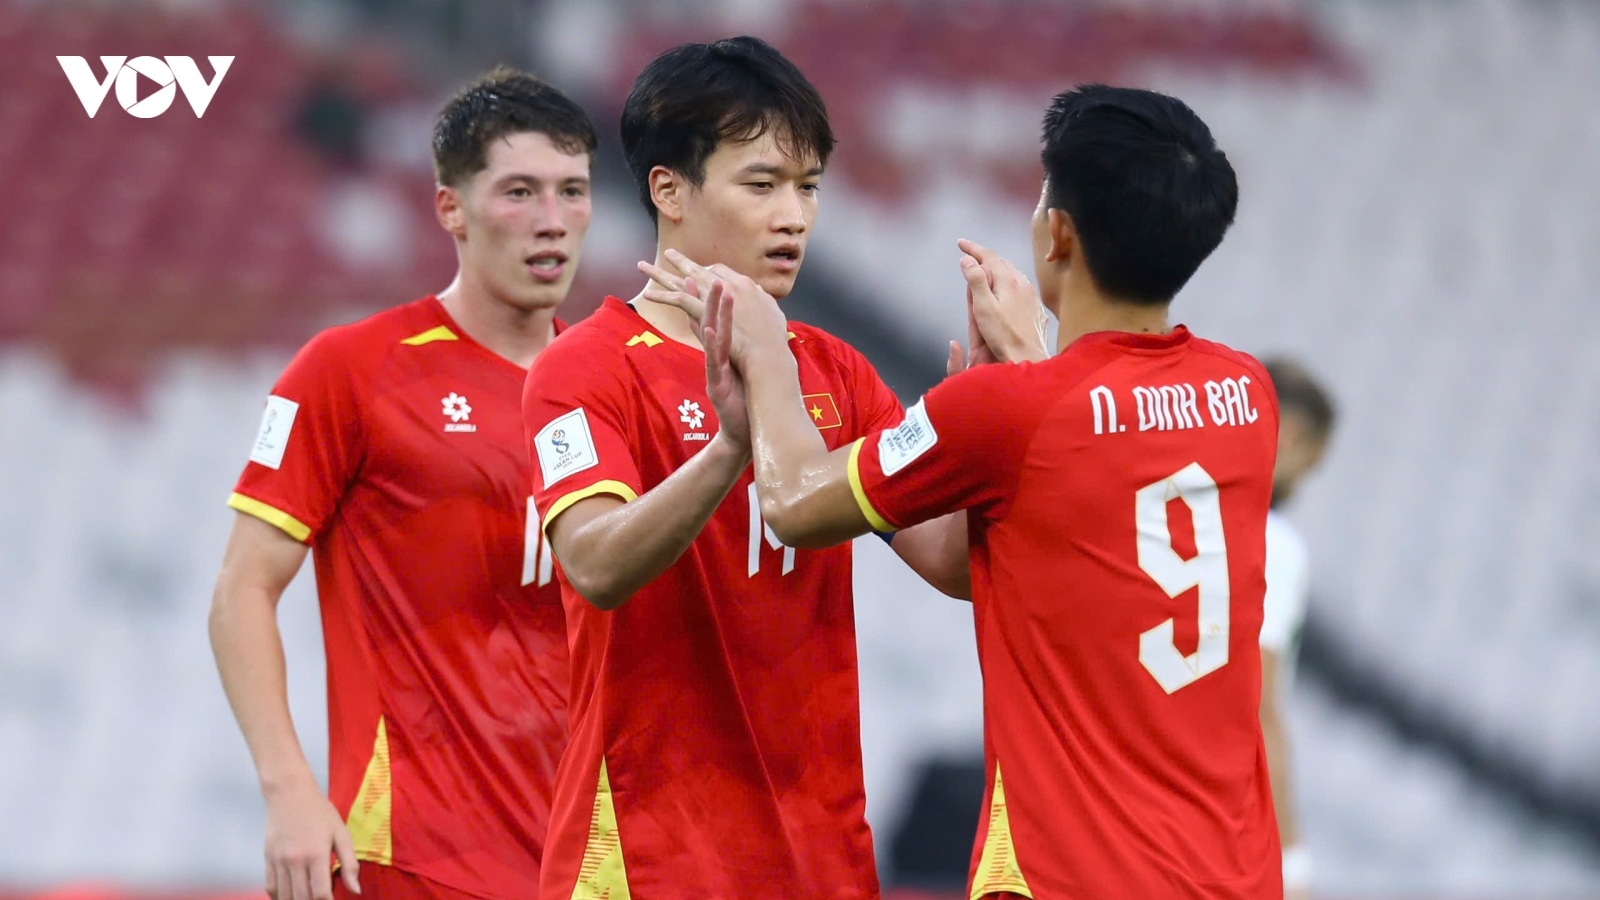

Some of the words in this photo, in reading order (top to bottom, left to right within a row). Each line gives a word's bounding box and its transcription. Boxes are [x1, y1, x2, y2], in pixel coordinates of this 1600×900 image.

[1090, 385, 1126, 435] N.
[1132, 383, 1204, 431] DINH
[1204, 375, 1258, 427] BAC
[553, 457, 570, 470] ASEAN
[570, 451, 582, 460] CUP
[1135, 461, 1230, 695] 9
